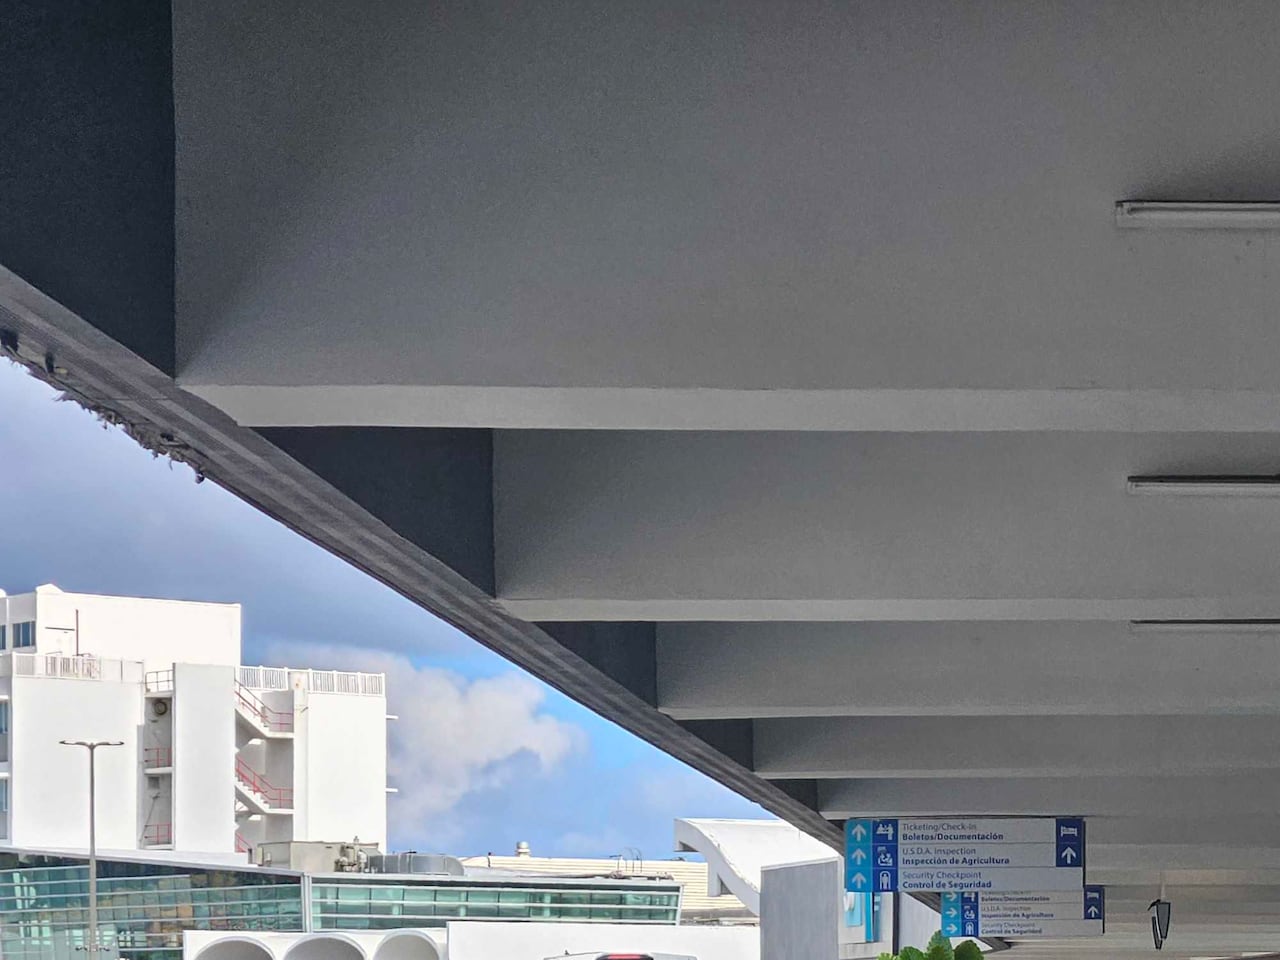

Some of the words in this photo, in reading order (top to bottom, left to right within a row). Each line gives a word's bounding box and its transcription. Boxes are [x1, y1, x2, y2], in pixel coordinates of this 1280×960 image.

[903, 823, 976, 832] Ticketing/Check-in
[902, 832, 1004, 841] Boletos/Documentación
[934, 847, 976, 856] Inspection
[902, 856, 947, 866] Inspección
[949, 857, 959, 865] de
[961, 857, 1010, 866] Agricultura
[902, 871, 934, 880] Security
[936, 871, 981, 880] Checkpoint
[902, 881, 934, 889] Control
[937, 881, 947, 889] de
[949, 881, 992, 890] Seguridad
